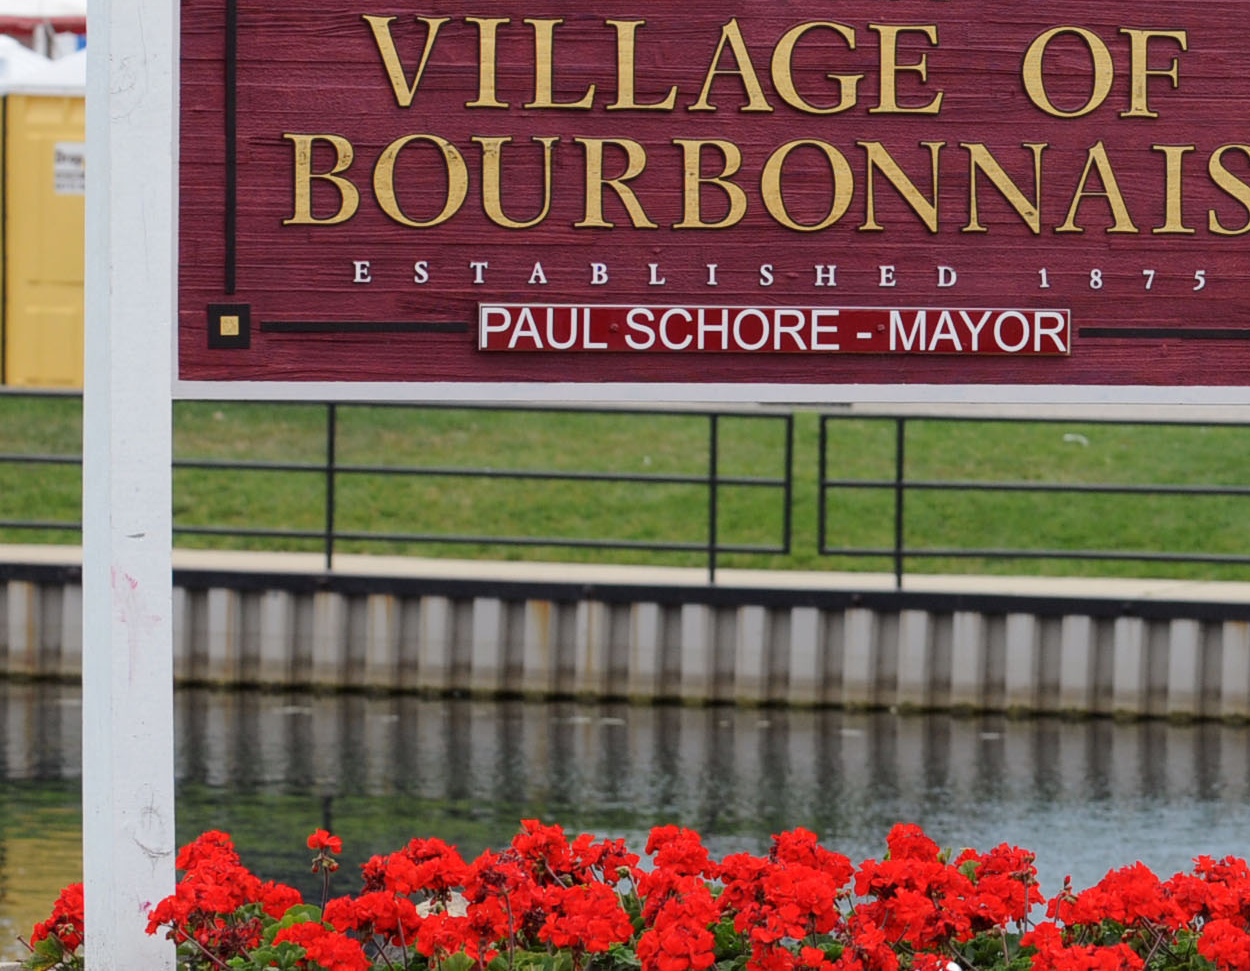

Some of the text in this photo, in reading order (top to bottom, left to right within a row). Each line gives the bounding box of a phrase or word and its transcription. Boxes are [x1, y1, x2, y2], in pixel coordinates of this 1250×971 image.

[361, 14, 1189, 119] VILLAGE OF
[353, 260, 1208, 292] ESTABLISHED 1875
[481, 308, 609, 350] PAUL
[624, 308, 840, 352] SCHORE
[889, 310, 1068, 353] MAYOR
